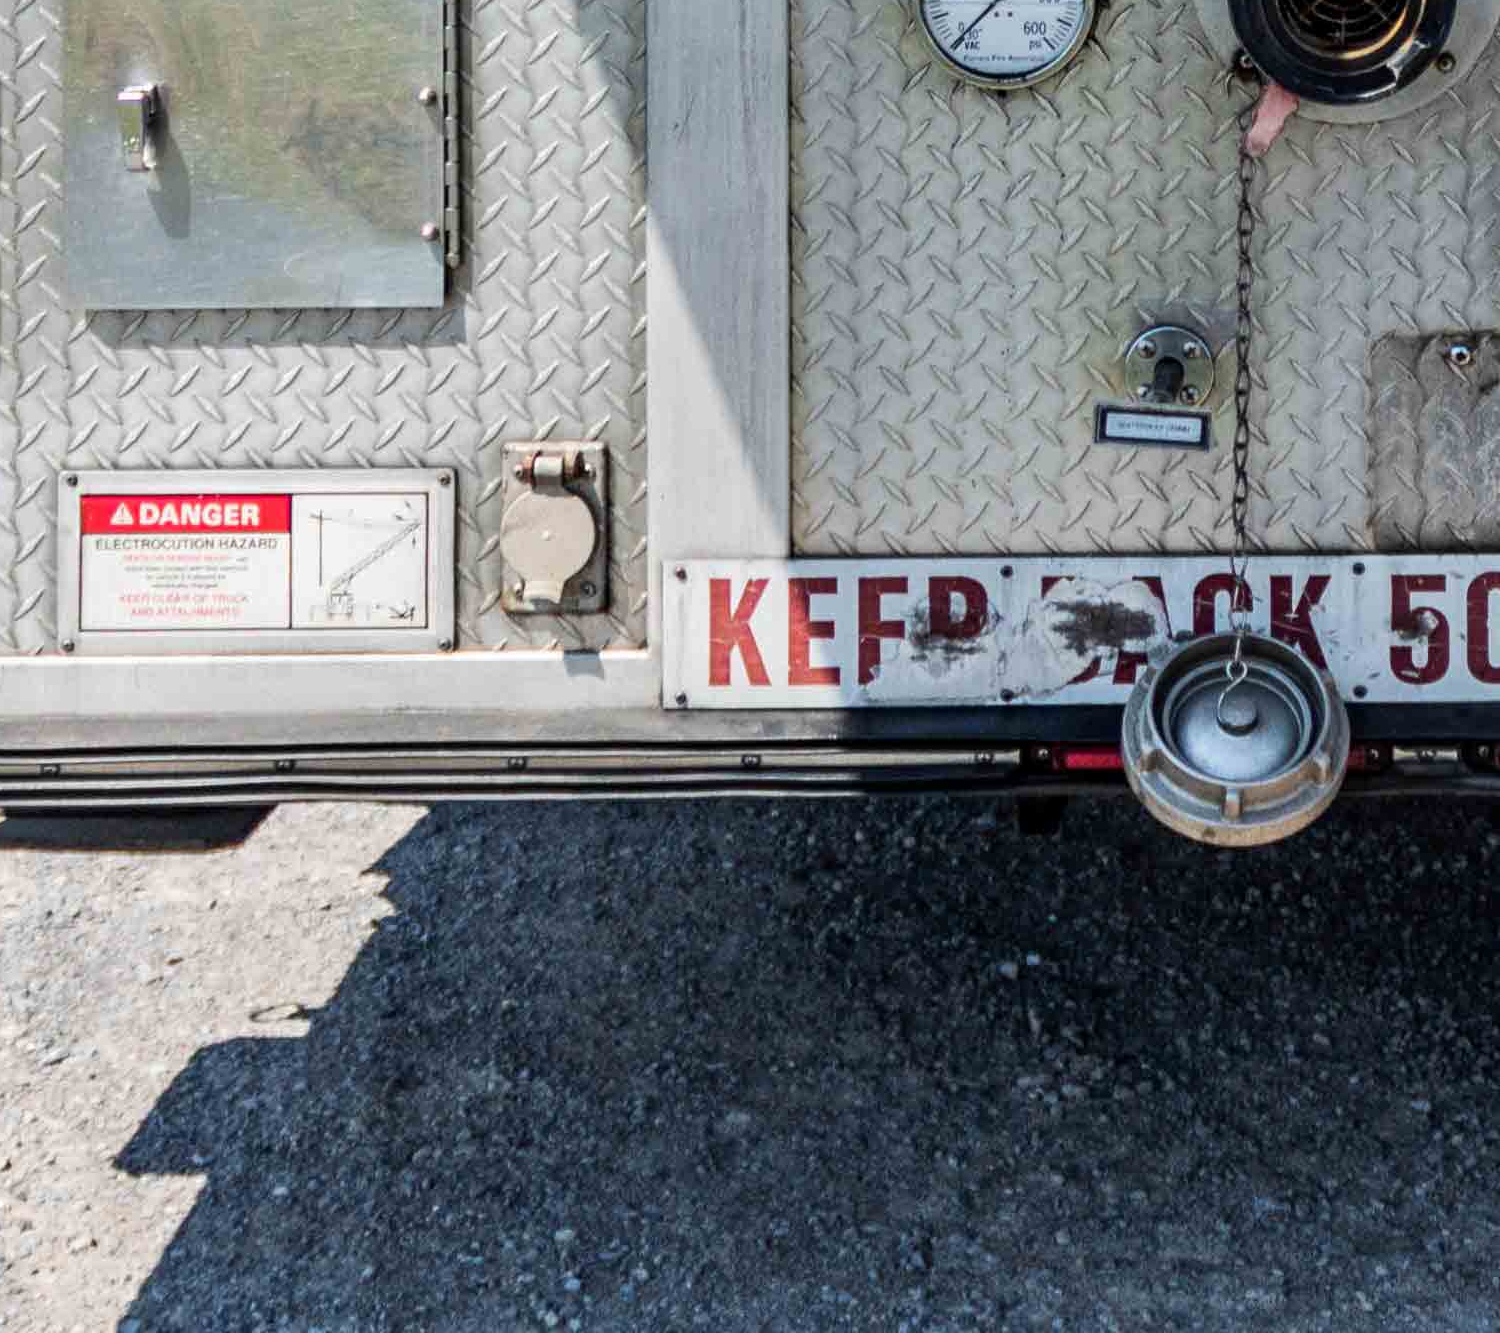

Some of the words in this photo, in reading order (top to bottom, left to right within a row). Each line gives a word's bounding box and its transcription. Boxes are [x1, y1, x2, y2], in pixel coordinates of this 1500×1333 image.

[1023, 21, 1046, 35] 600
[139, 502, 260, 526] DANGER
[95, 537, 215, 550] ELECTROCUTION
[218, 537, 278, 550] HAZARD
